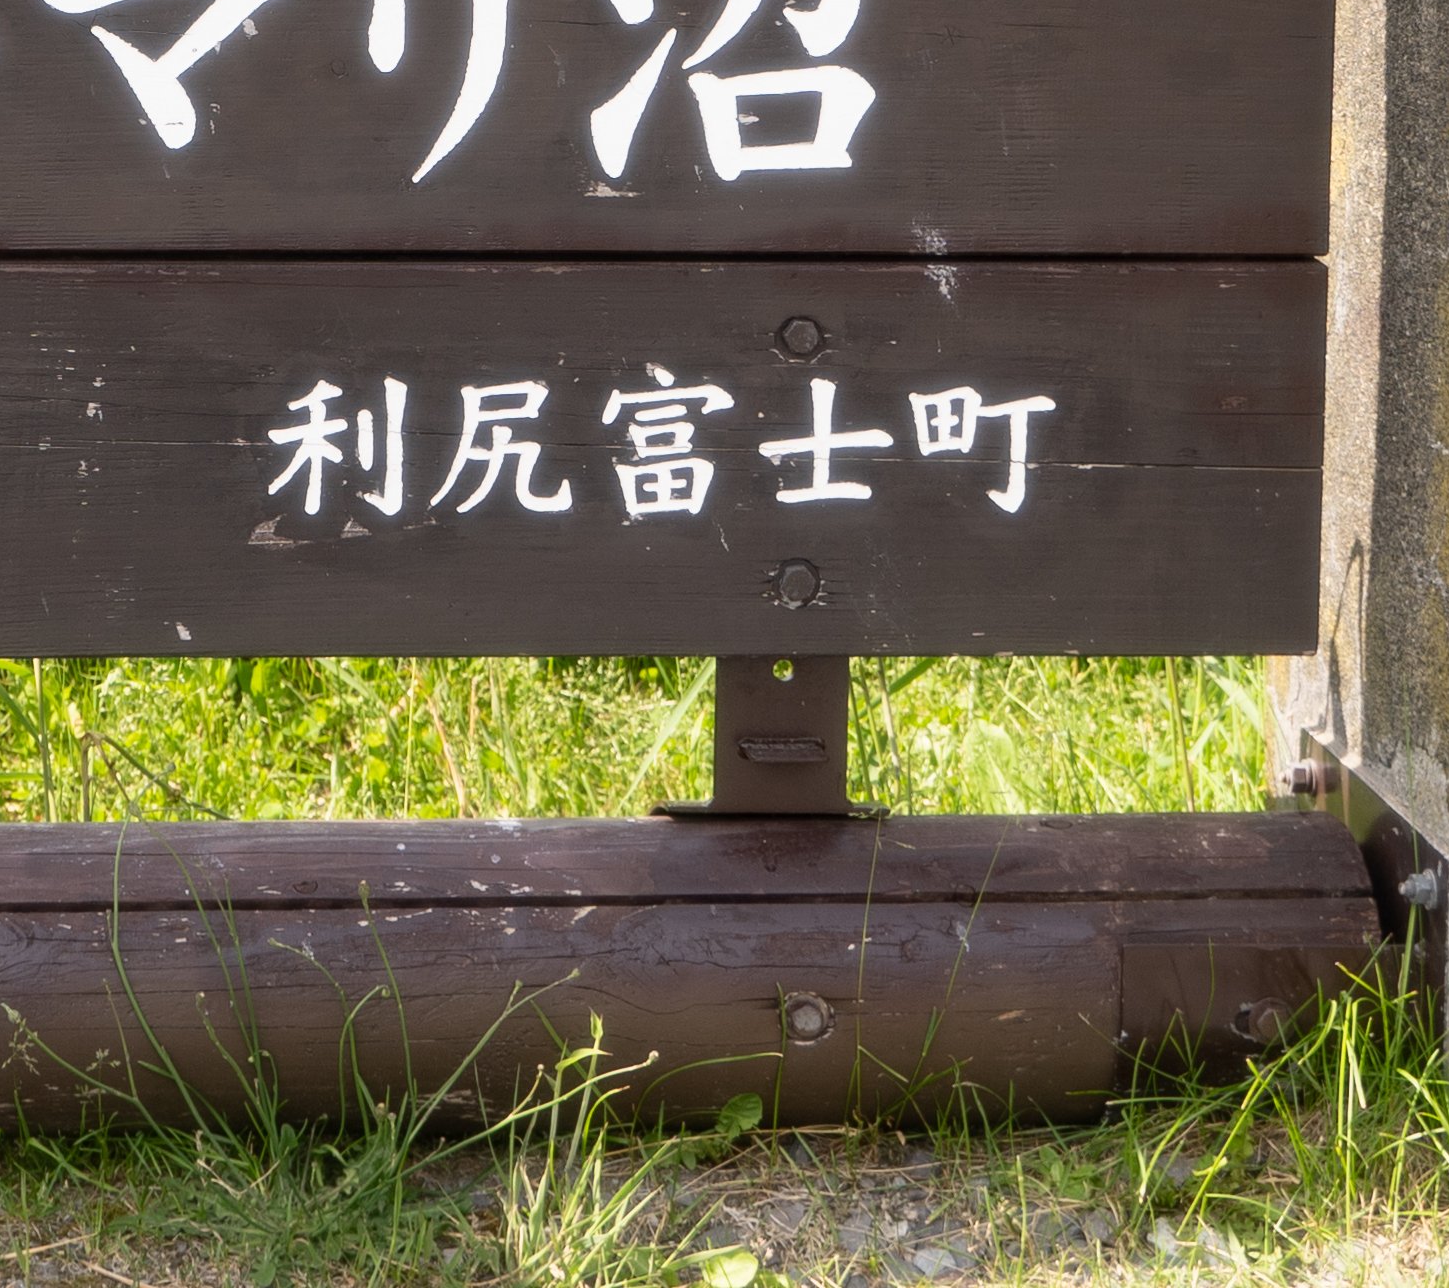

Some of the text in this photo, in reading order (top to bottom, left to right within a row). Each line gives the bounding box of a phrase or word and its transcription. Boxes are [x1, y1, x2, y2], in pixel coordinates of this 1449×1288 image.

[266, 376, 1058, 522] 利尻富士町
